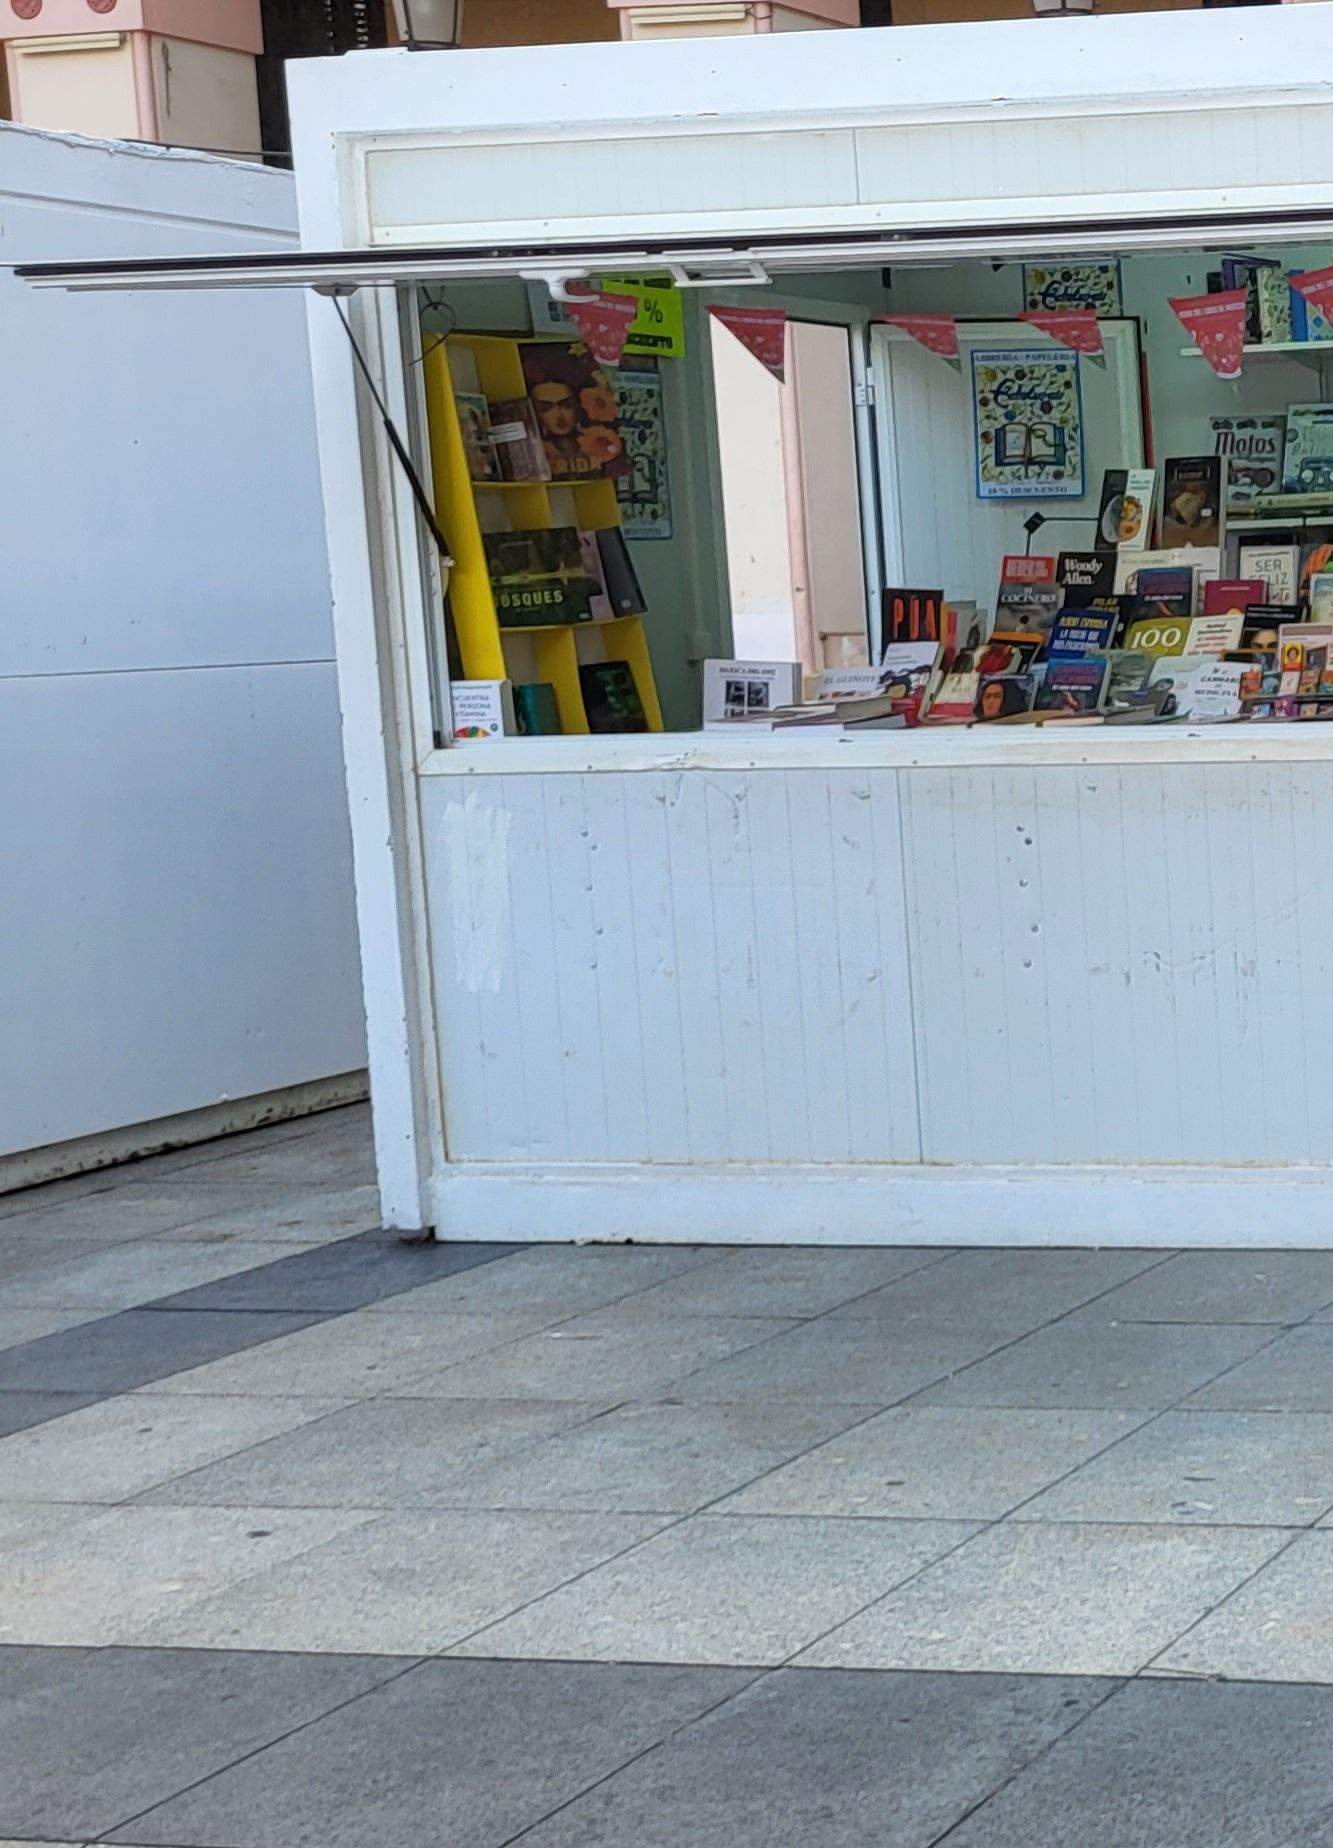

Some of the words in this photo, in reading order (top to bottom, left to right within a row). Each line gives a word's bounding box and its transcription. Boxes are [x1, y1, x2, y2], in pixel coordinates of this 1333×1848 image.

[1215, 431, 1276, 455] Motos
[1064, 558, 1103, 575] Woody
[1255, 559, 1282, 572] SER
[495, 589, 564, 608] OSQUES
[1131, 627, 1182, 648] 100
